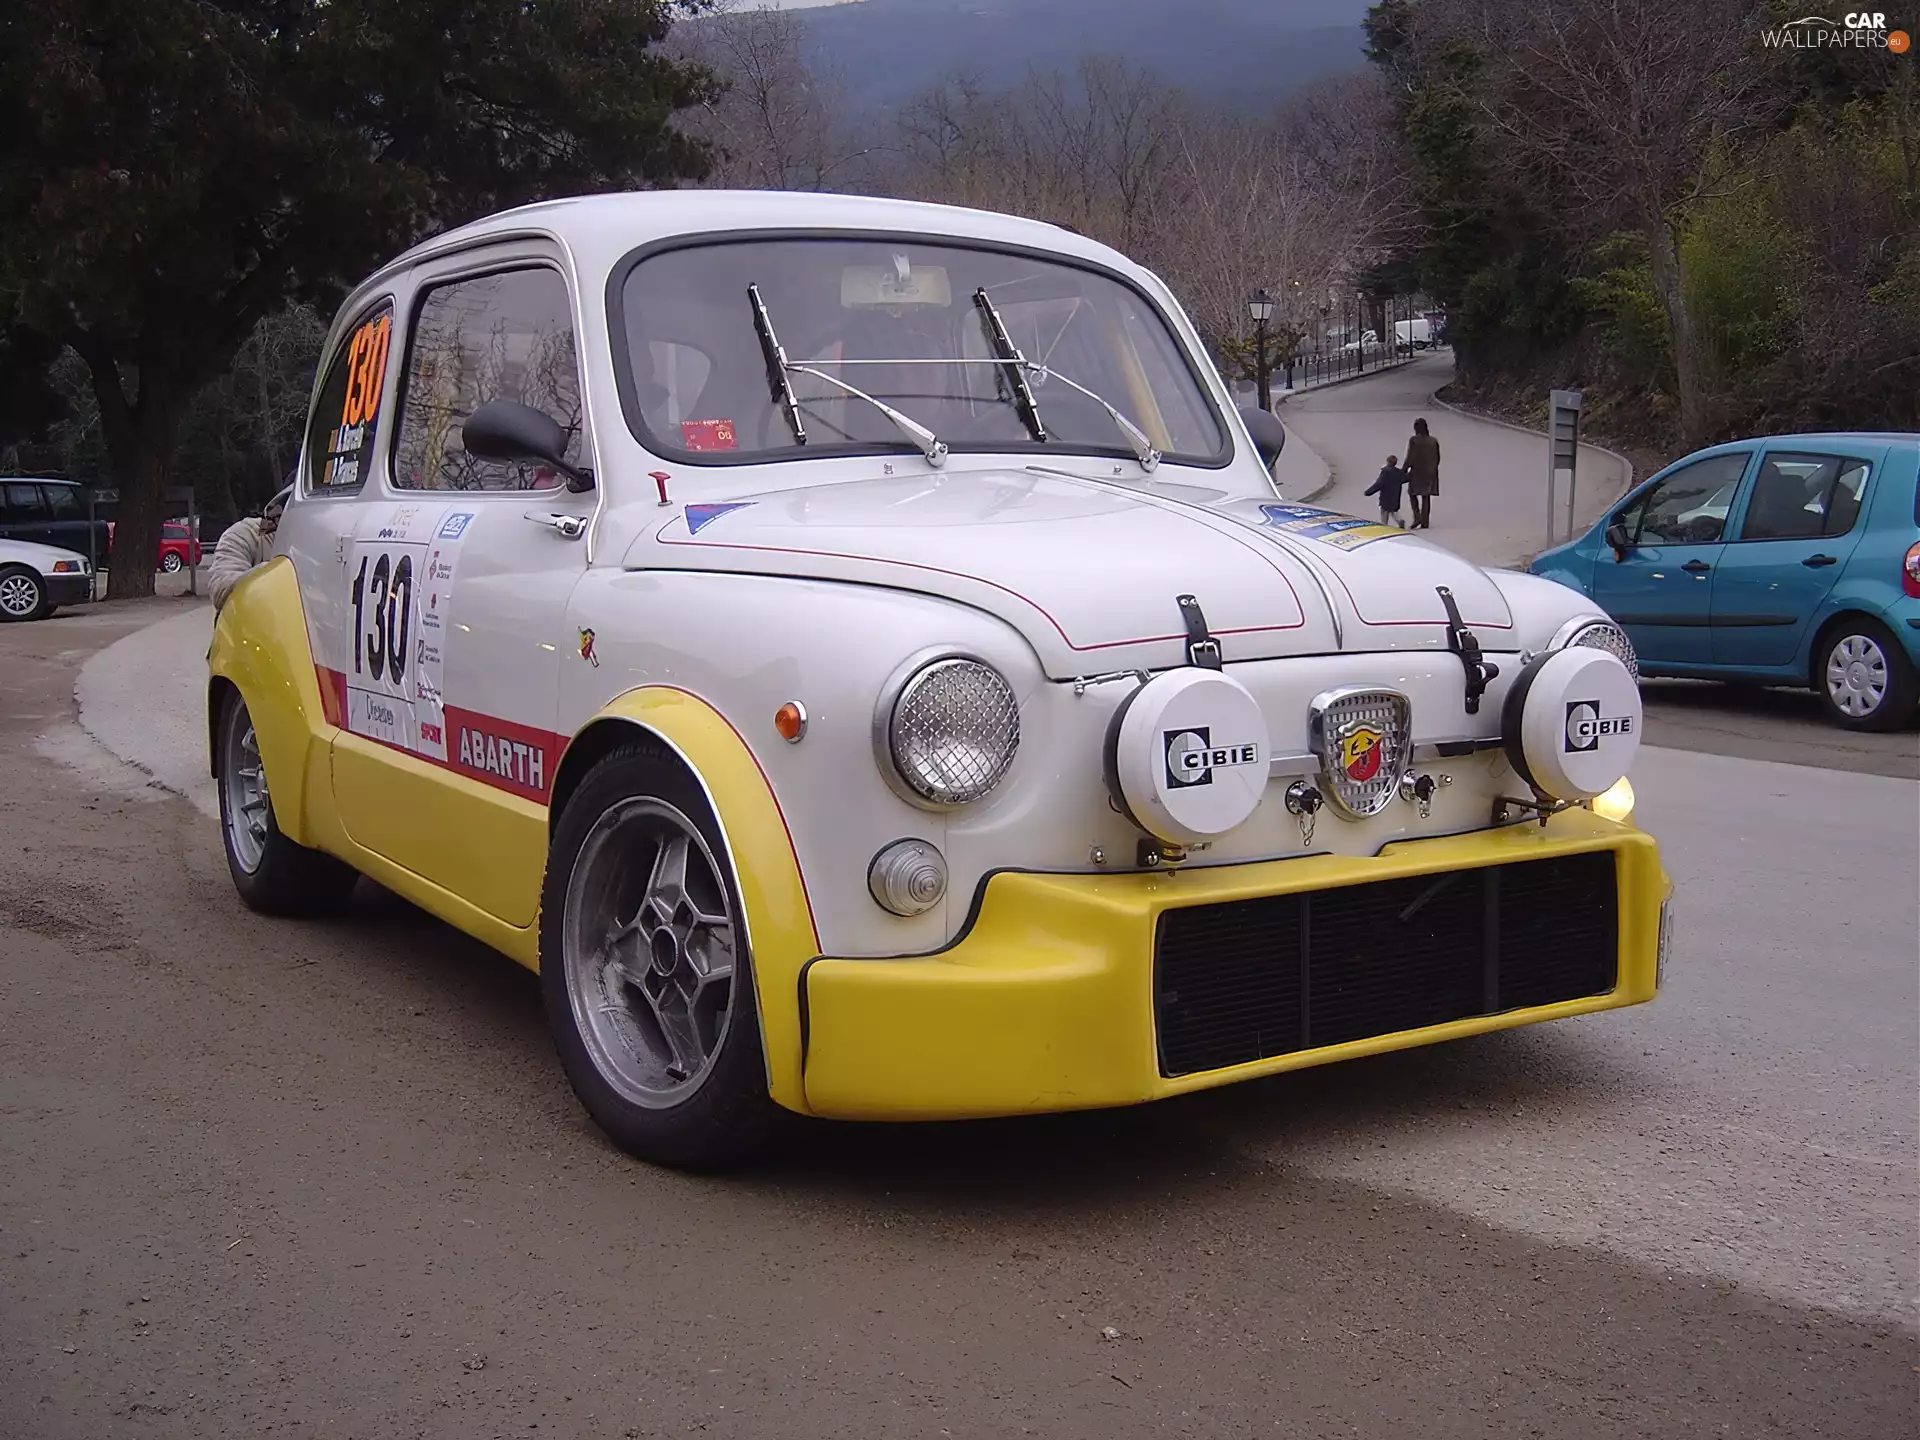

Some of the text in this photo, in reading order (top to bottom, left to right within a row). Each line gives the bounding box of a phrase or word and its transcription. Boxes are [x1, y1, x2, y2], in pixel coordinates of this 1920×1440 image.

[342, 314, 390, 426] 130
[351, 553, 412, 686] 130
[460, 727, 544, 790] ABARTH
[1183, 746, 1254, 768] CIBIE
[1579, 719, 1630, 736] CIBIE
